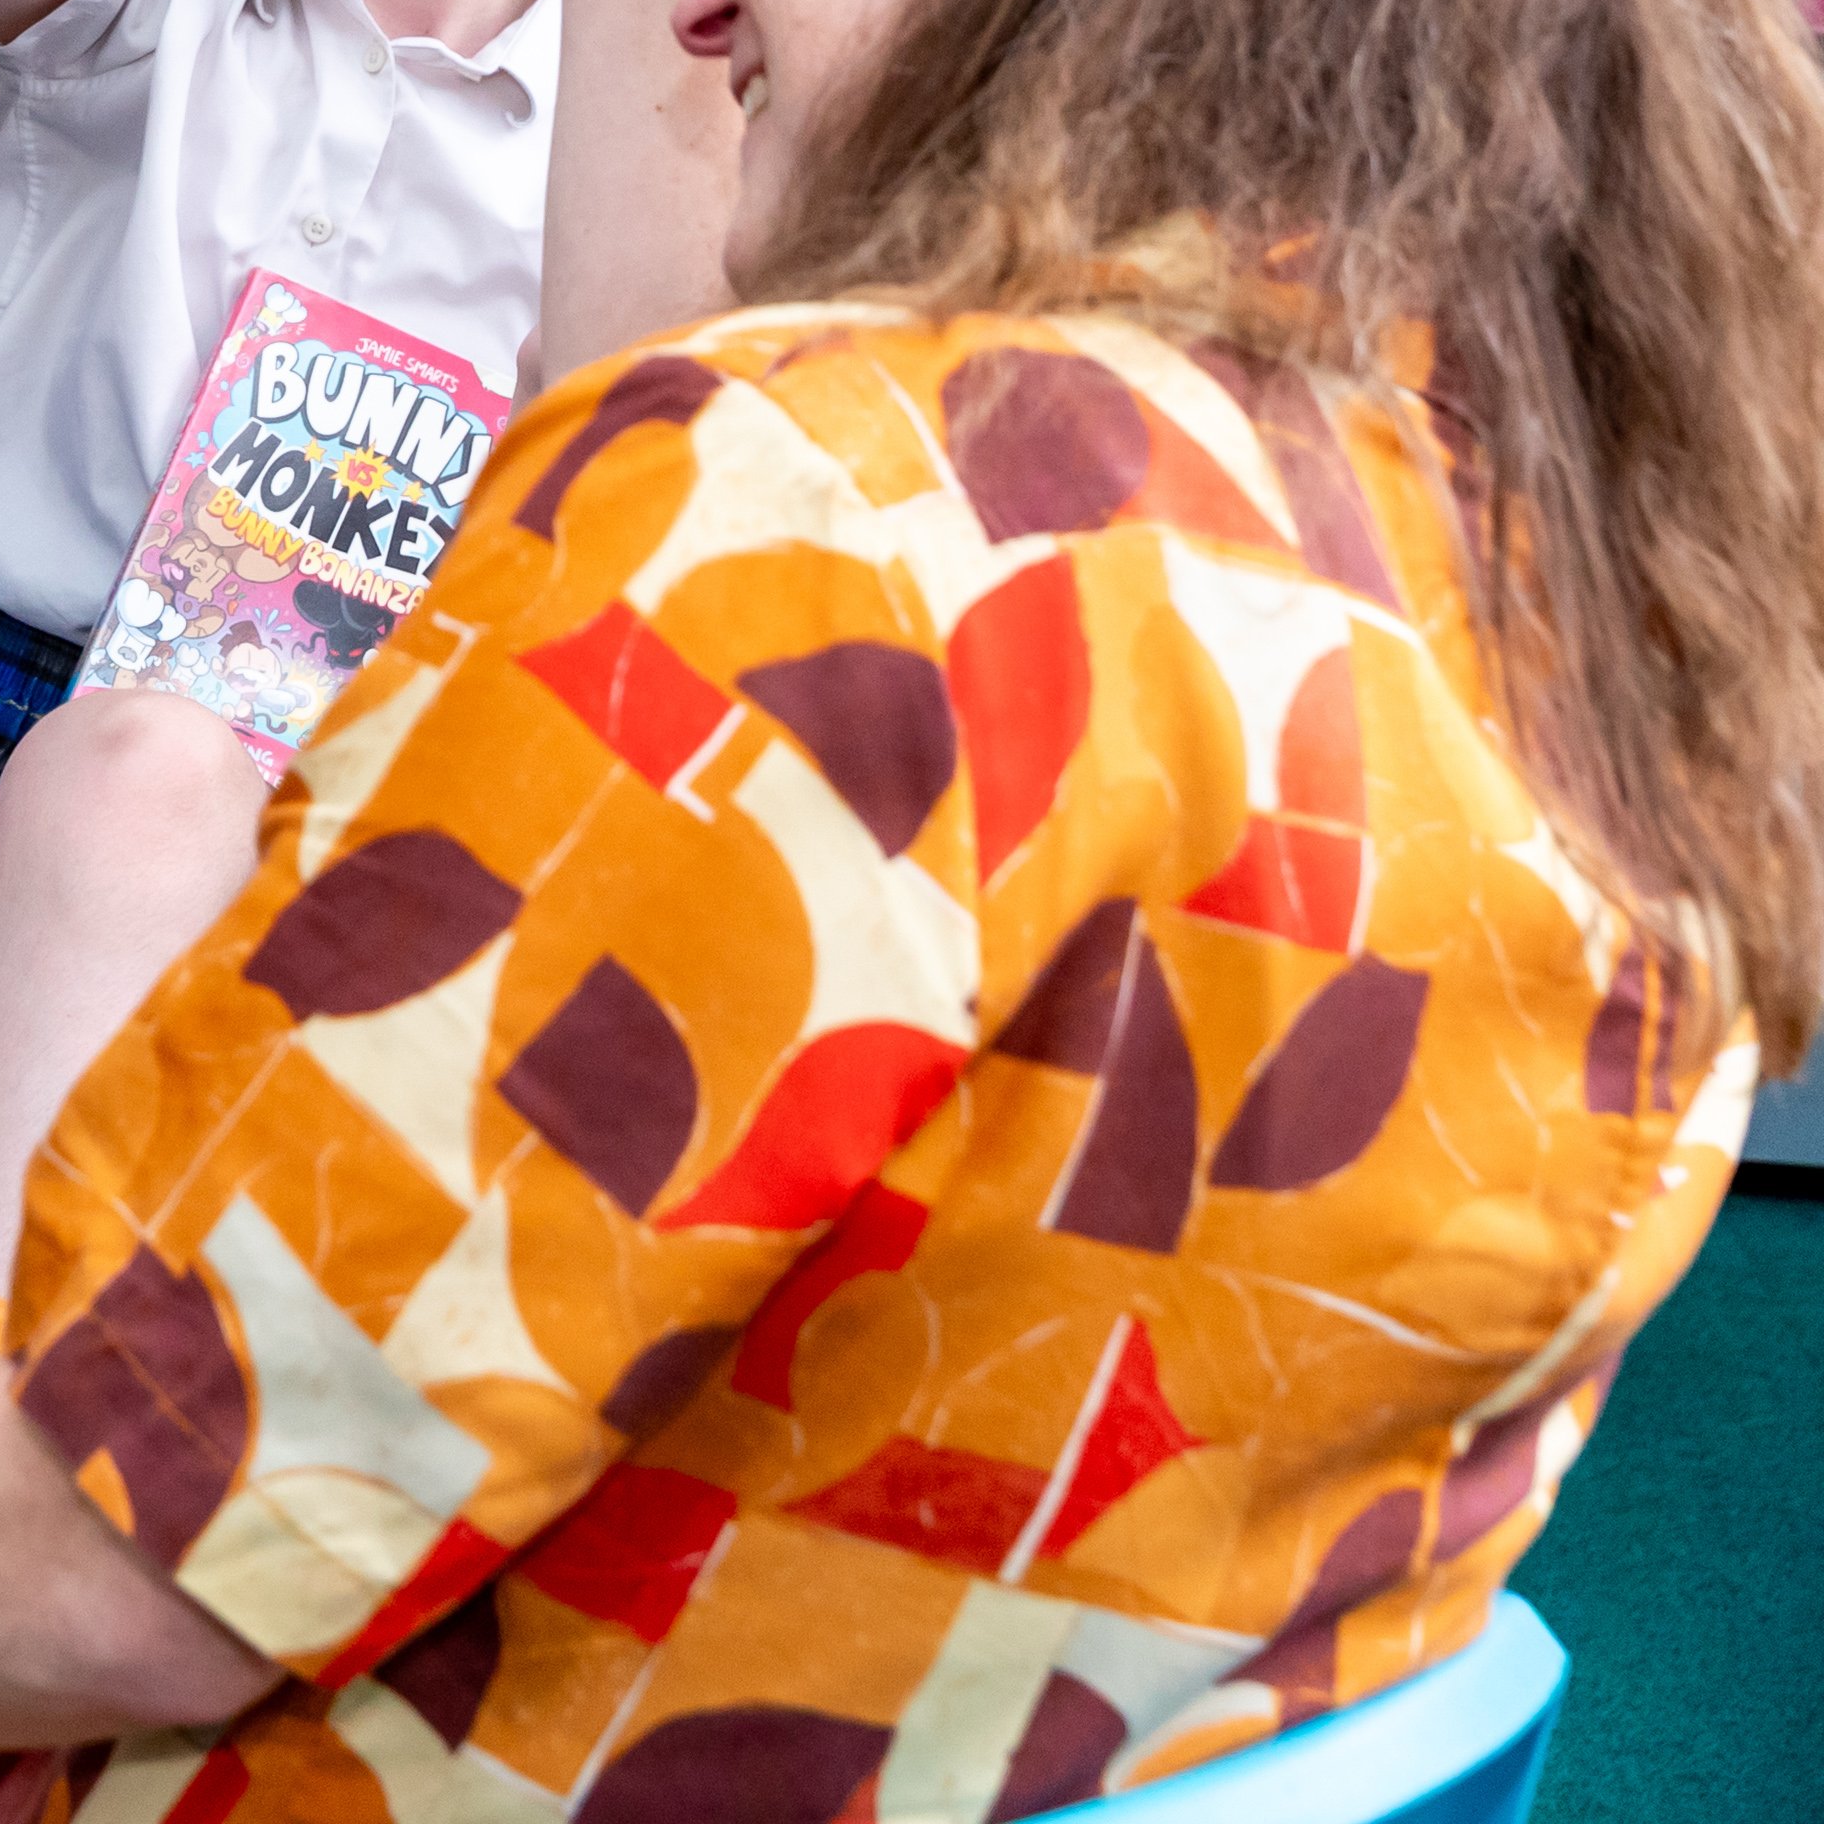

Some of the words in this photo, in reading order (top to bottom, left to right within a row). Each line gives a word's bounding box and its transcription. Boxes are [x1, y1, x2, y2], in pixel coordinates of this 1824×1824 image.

[354, 337, 406, 366] JAMIE
[251, 341, 492, 509] BUNNY
[346, 458, 378, 488] VS
[206, 486, 306, 567] BUNNY
[298, 541, 425, 616] BONANZA
